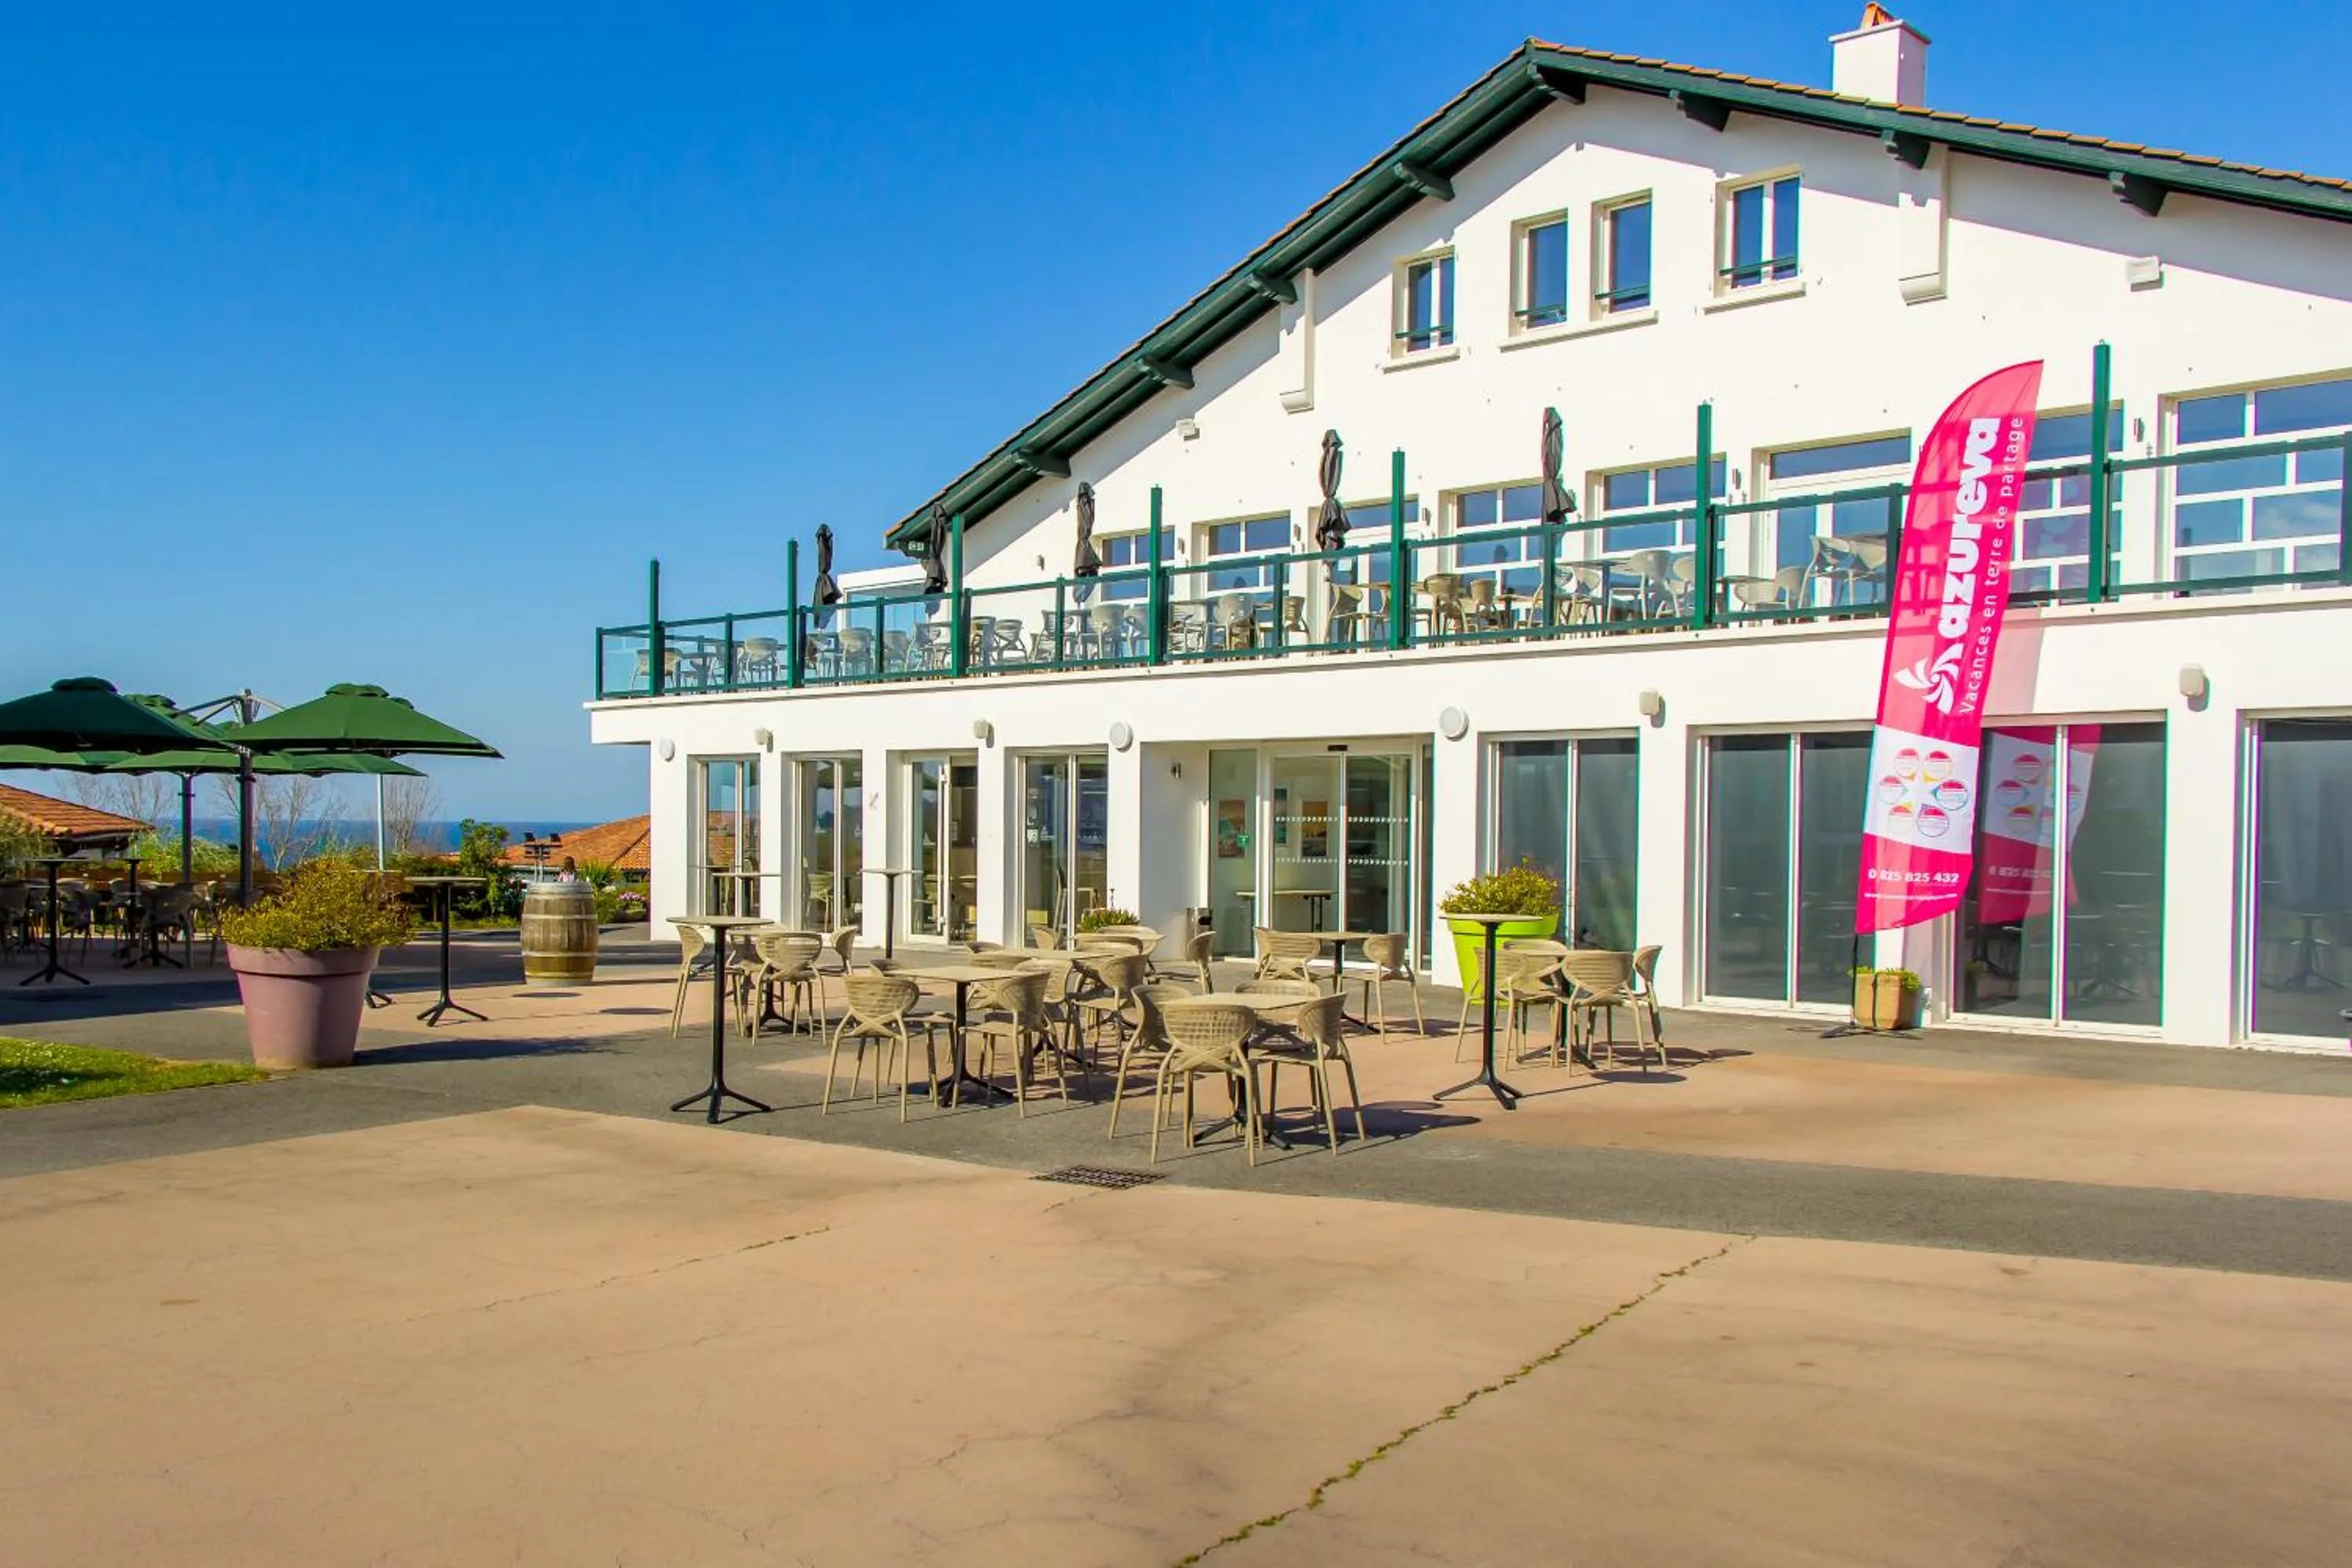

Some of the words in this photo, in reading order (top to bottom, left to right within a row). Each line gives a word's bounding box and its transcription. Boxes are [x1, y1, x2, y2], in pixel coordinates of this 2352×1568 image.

[2001, 418, 2025, 496] partage
[1938, 418, 2001, 639] azureva
[1993, 506, 2007, 529] de
[1984, 538, 2003, 586] terre
[1982, 594, 1998, 618] en
[1960, 626, 1991, 714] Vacances
[1868, 868, 1876, 879] 0
[1880, 869, 1902, 881] 825
[1905, 871, 1930, 883] 825
[1933, 872, 1959, 883] 432
